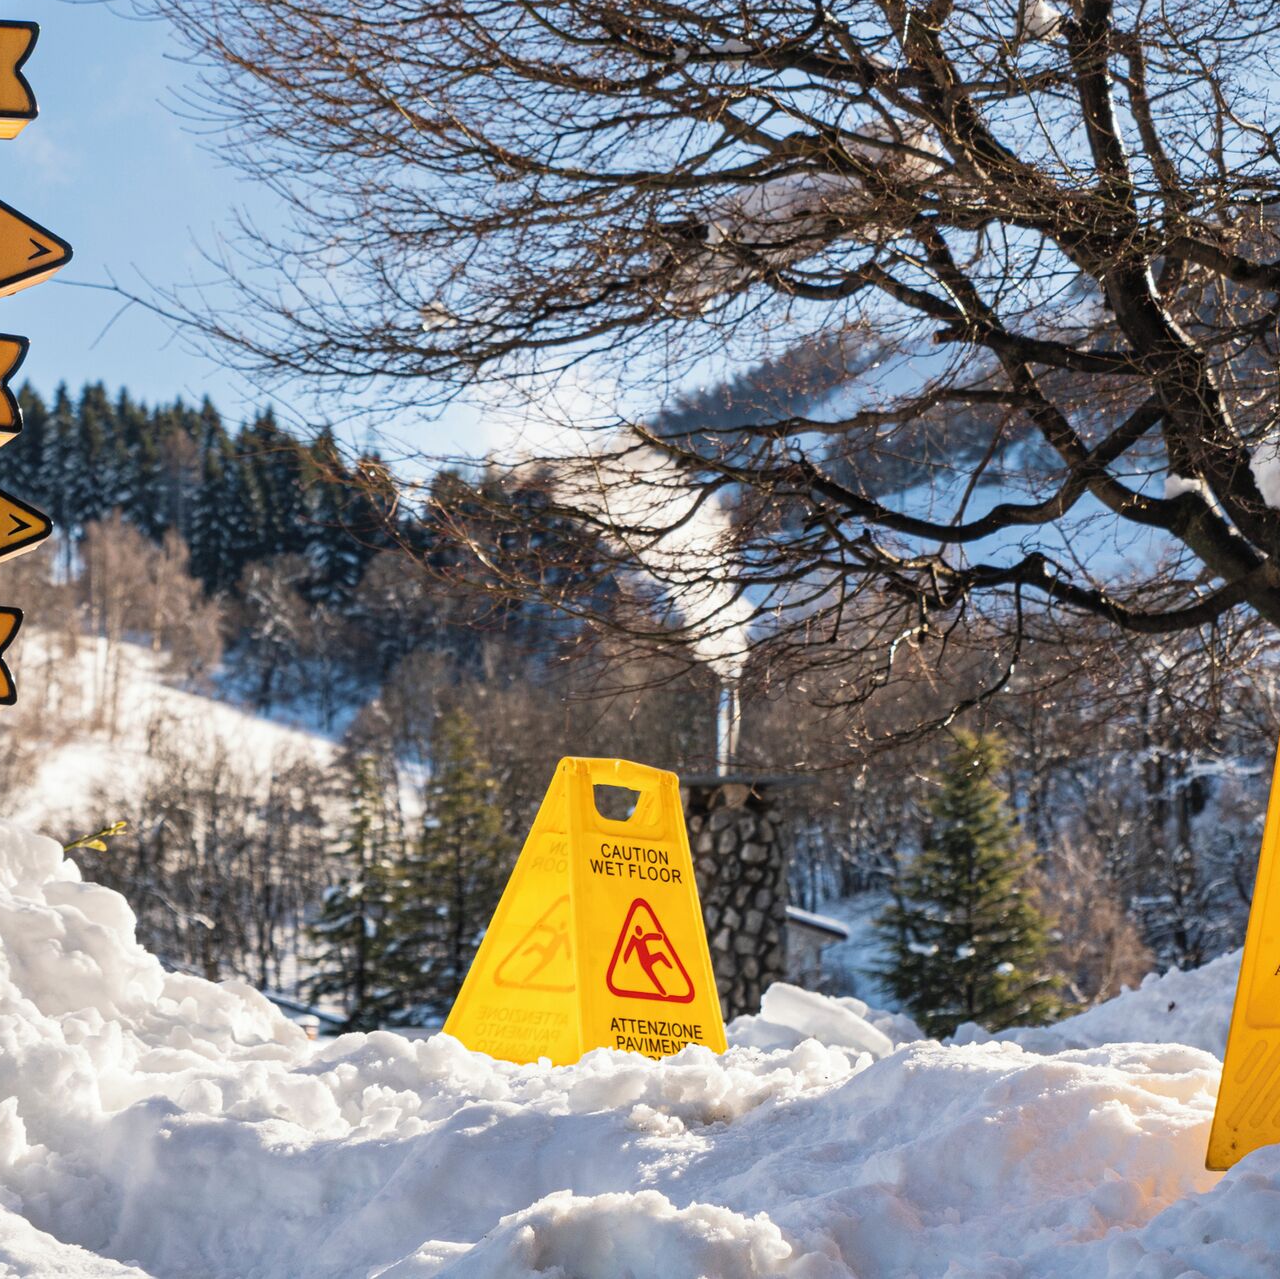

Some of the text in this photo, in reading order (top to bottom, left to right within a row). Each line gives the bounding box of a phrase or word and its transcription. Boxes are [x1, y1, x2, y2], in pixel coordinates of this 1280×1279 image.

[601, 844, 668, 865] CAUTION
[590, 859, 682, 884] WET FLOOR
[611, 1018, 703, 1039] ATTENZIONE
[616, 1036, 700, 1054] PAVIMENT
